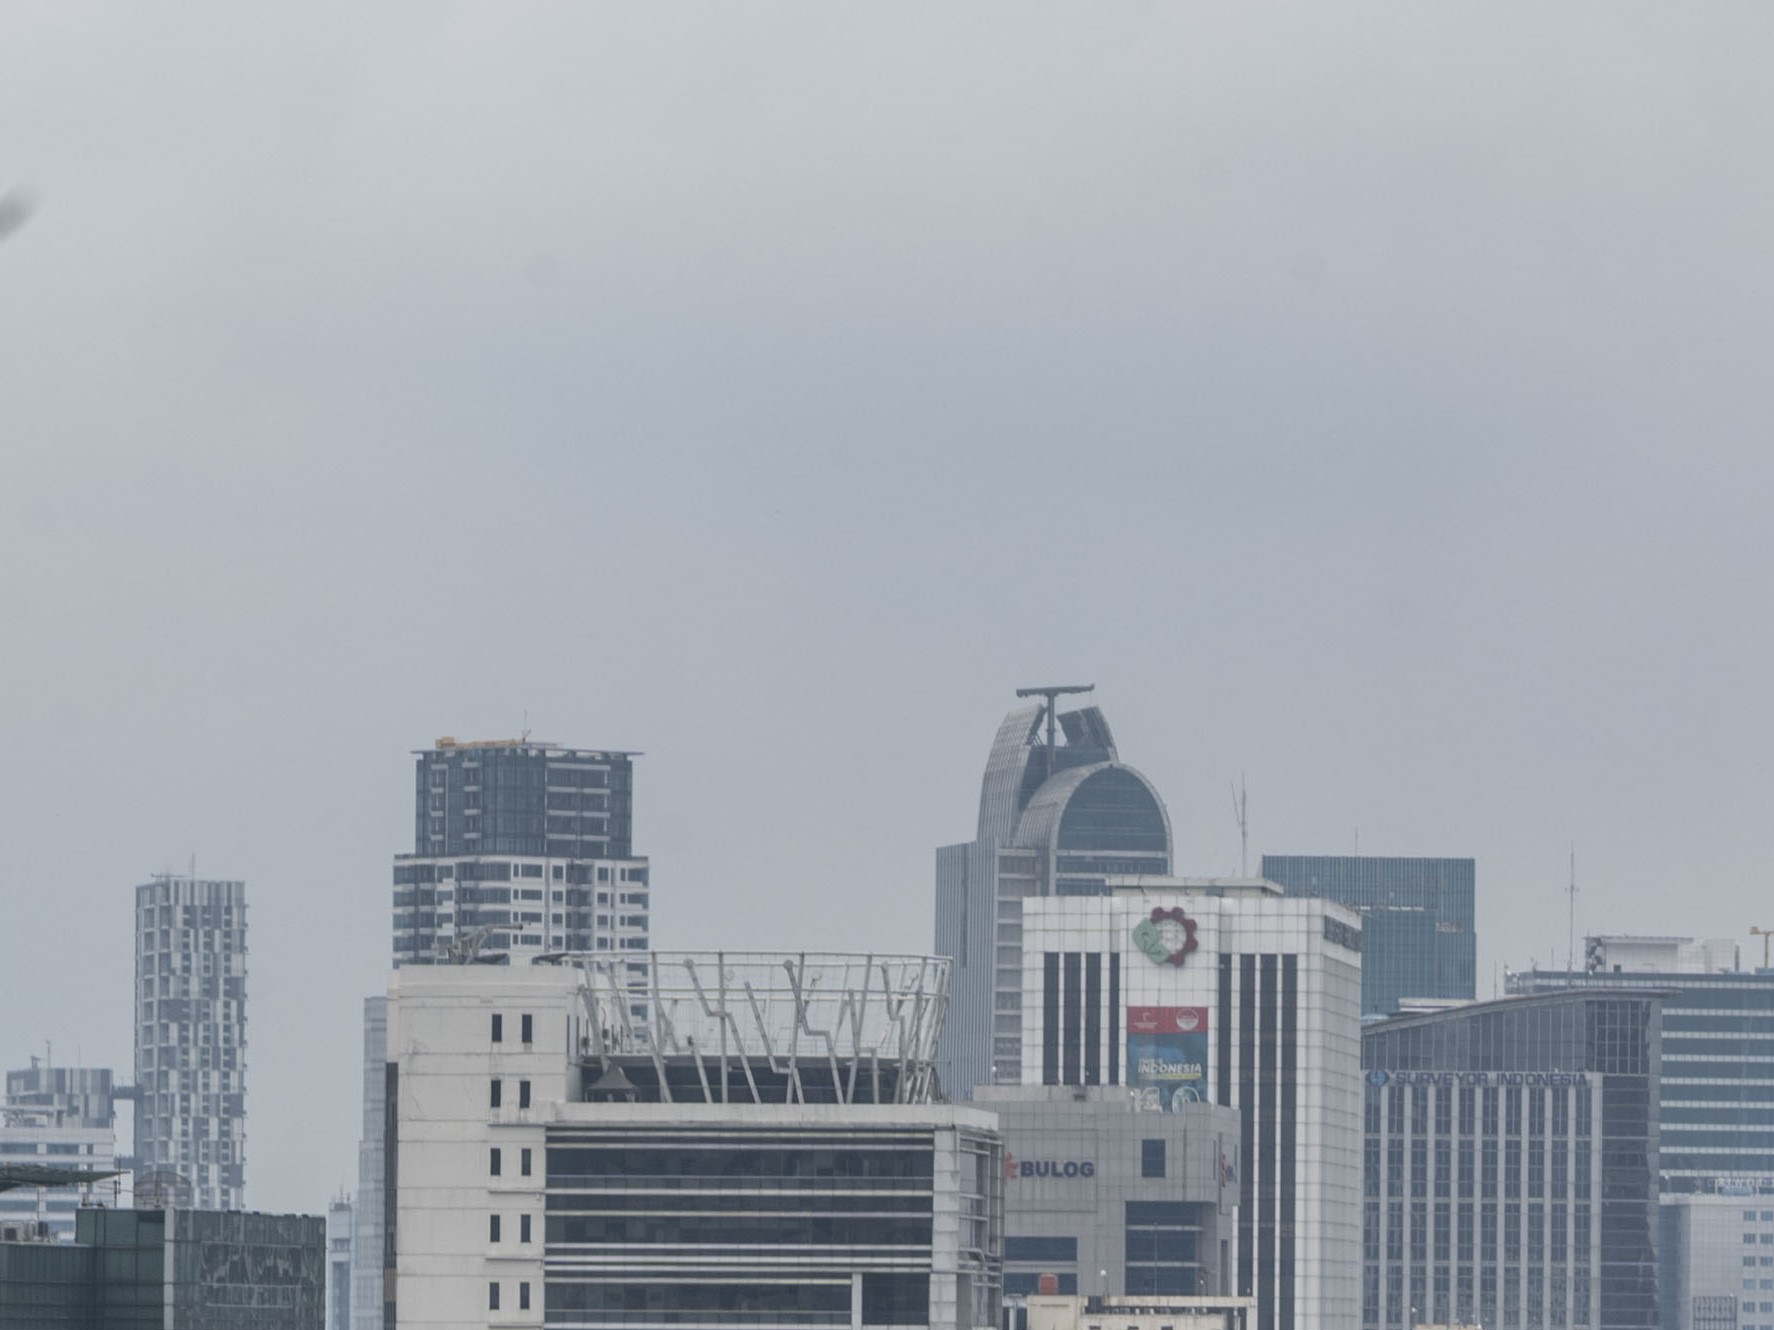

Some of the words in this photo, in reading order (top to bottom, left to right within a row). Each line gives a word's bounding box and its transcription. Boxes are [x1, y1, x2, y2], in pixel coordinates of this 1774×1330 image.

[1138, 1063, 1202, 1074] INDONESIA
[1395, 1071, 1489, 1087] SURVEYOR
[1496, 1071, 1588, 1087] INDONESIA
[1020, 1160, 1096, 1178] BULOG
